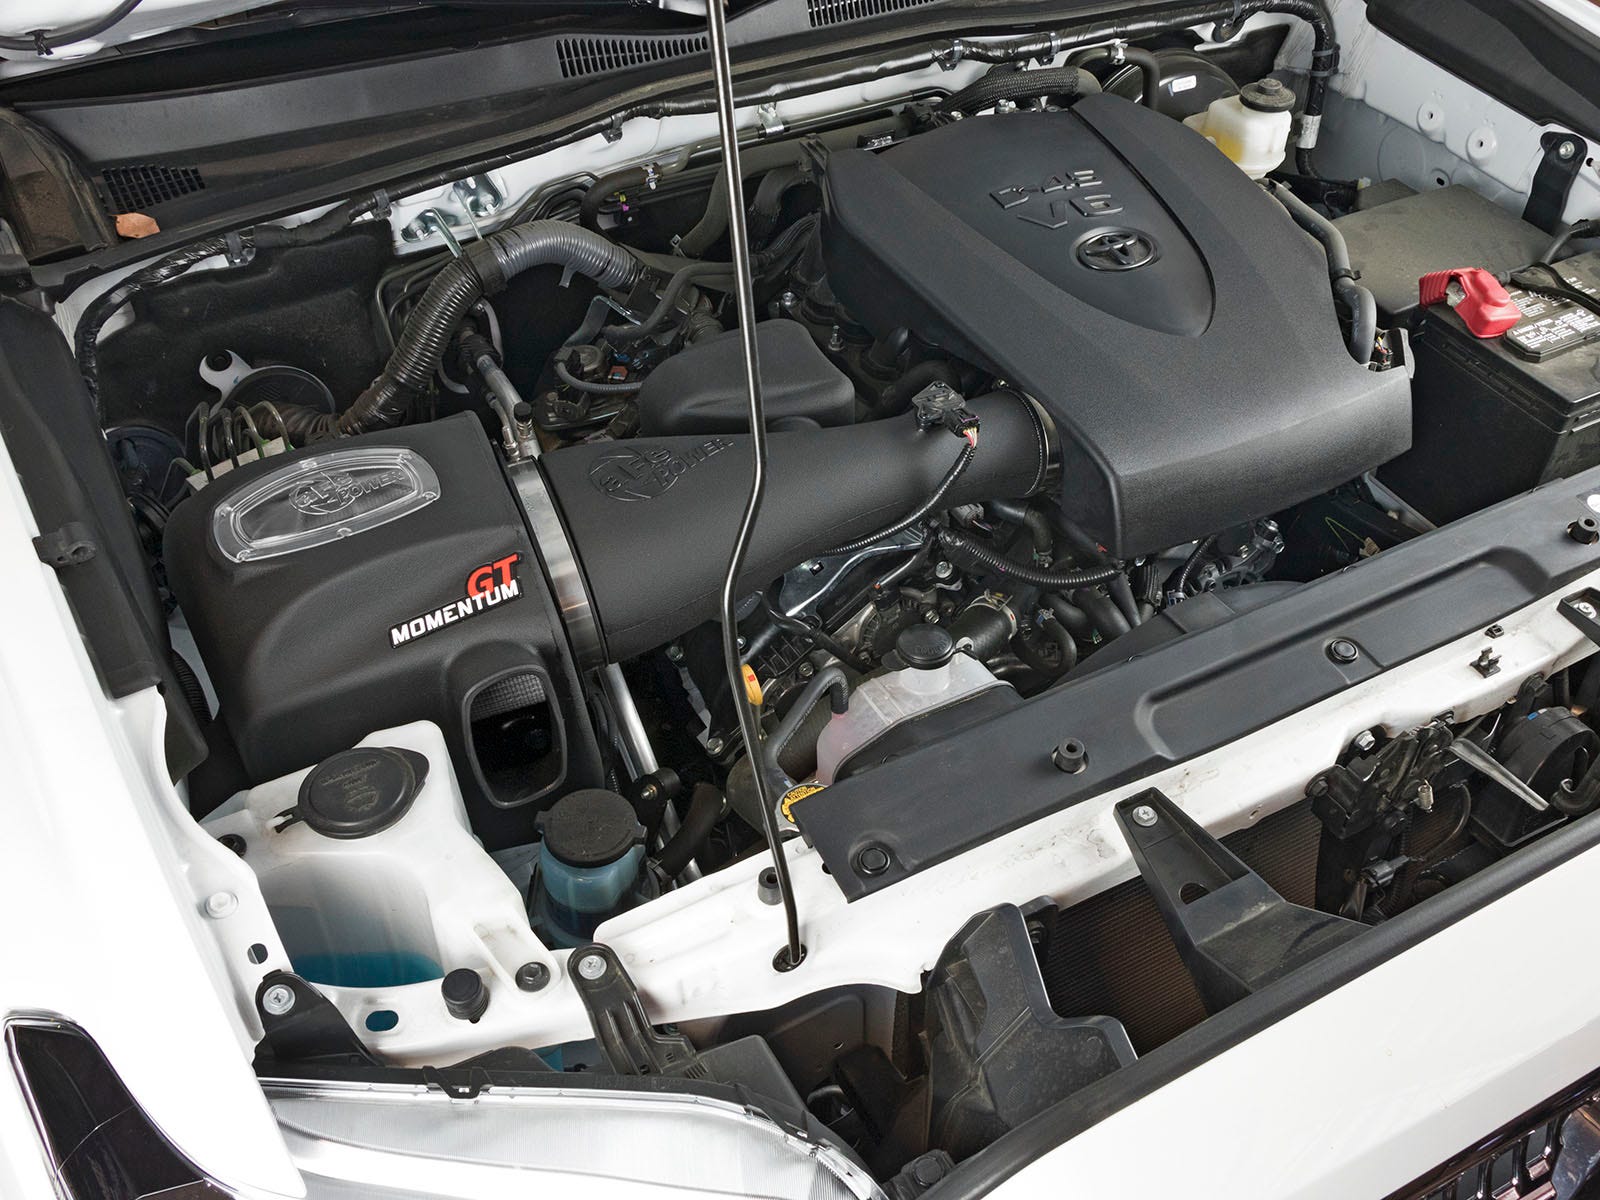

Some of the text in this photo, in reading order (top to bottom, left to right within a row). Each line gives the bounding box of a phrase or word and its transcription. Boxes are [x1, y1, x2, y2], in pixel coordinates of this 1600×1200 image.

[1017, 195, 1125, 229] V6
[654, 439, 734, 486] POWER
[337, 472, 405, 506] POWER
[467, 553, 520, 599] GT
[391, 580, 519, 646] MOMENTUM
